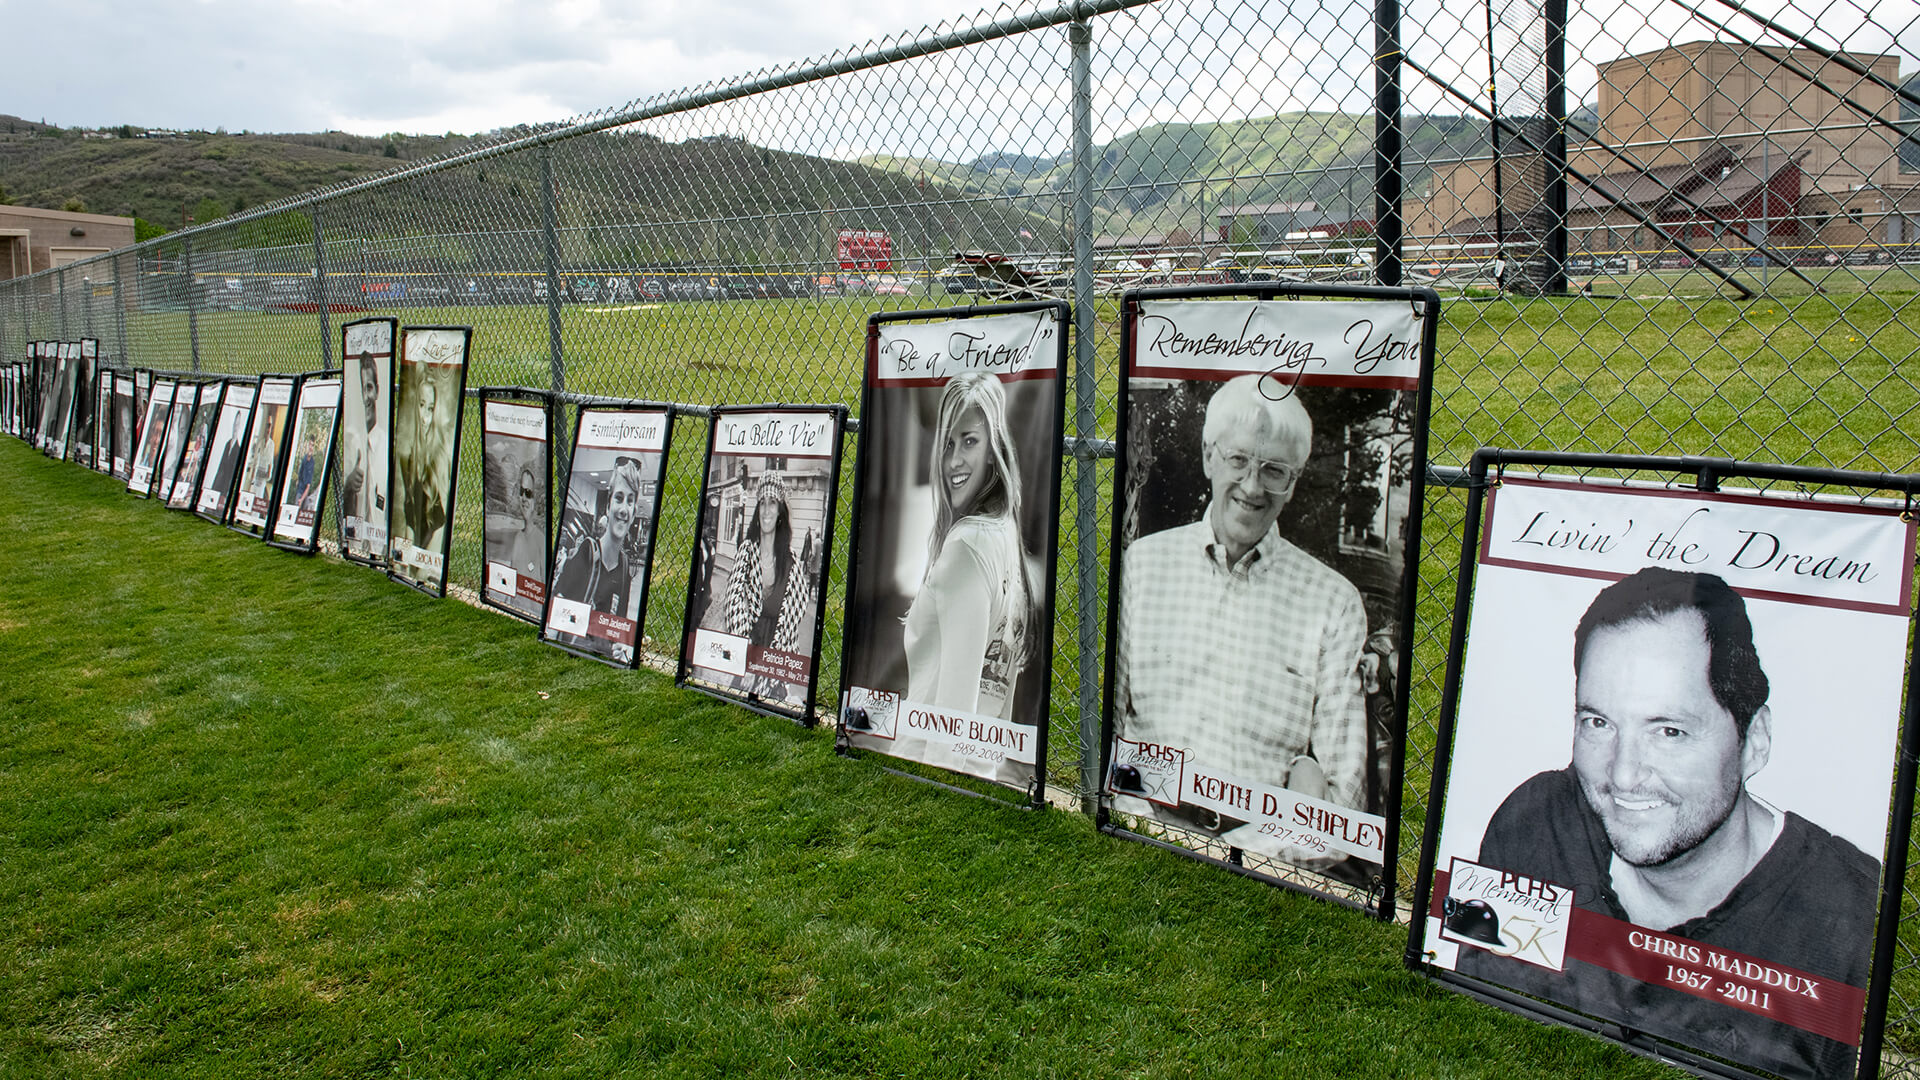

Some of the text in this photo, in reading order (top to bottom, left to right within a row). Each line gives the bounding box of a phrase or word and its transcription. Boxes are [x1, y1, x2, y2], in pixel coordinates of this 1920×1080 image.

[926, 352, 946, 380] a
[1142, 305, 1420, 401] Remembering You
[591, 419, 657, 444] #smilesforsam
[725, 420, 825, 448] "La Belle Vie"
[1646, 508, 1710, 565] the
[1727, 529, 1879, 584] Dream
[598, 614, 610, 627] Sam
[748, 661, 769, 673] September
[788, 671, 796, 681] May
[762, 651, 804, 670] Patricia Papez
[868, 689, 893, 702] PCHS
[908, 710, 1030, 752] CONNIE BLOUNT
[952, 742, 1005, 764] 1989-2008
[1117, 744, 1184, 776] Memorial
[1138, 742, 1175, 762] PCHS
[1141, 771, 1176, 804] 5K
[1193, 773, 1385, 851] KEITH D. SHIPLEY
[1257, 822, 1329, 853] 1927-1995
[1455, 867, 1574, 922] Memorial
[1500, 872, 1558, 902] PCHS
[1490, 915, 1569, 971] 5K
[1628, 931, 1821, 1001] CHRIS MADDUX
[1665, 965, 1770, 1010] 1957 -2011
